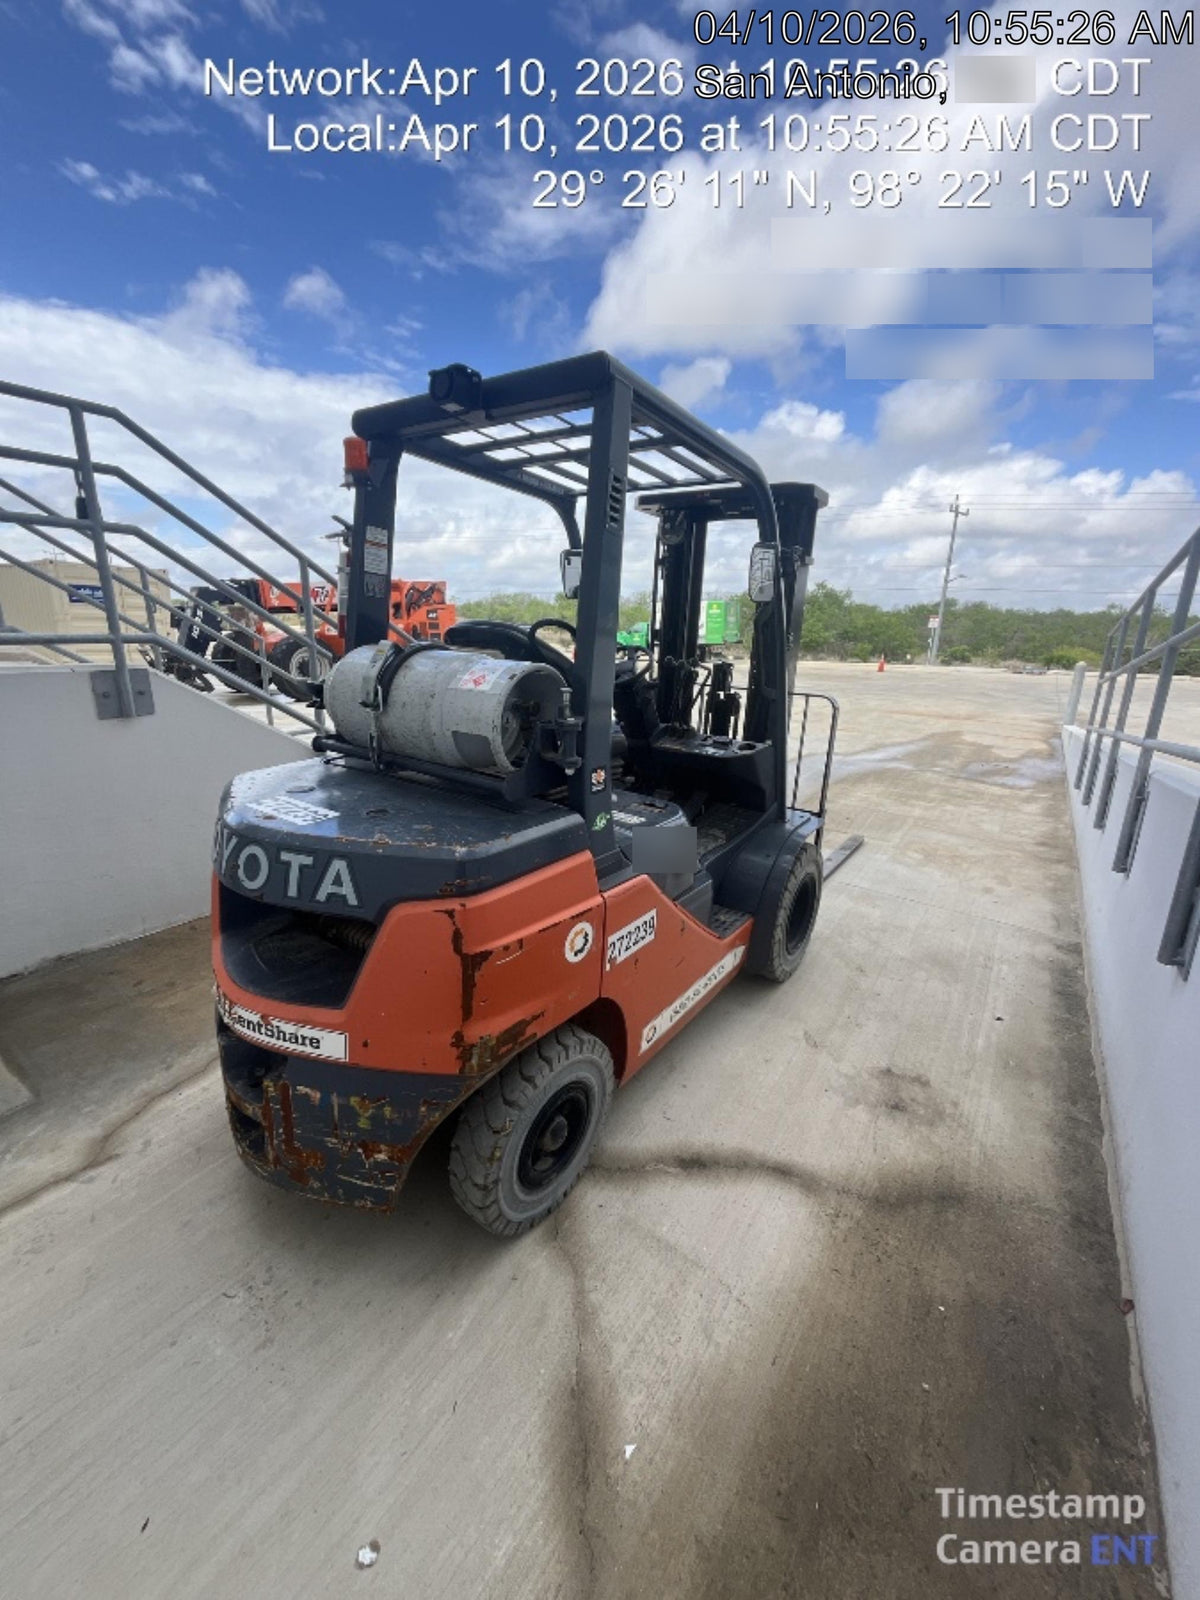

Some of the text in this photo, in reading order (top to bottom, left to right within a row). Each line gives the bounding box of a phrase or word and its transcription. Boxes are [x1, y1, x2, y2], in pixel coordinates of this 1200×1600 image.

[213, 829, 358, 906] YOTA
[608, 915, 655, 964] 272239
[230, 1013, 321, 1050] entShare
